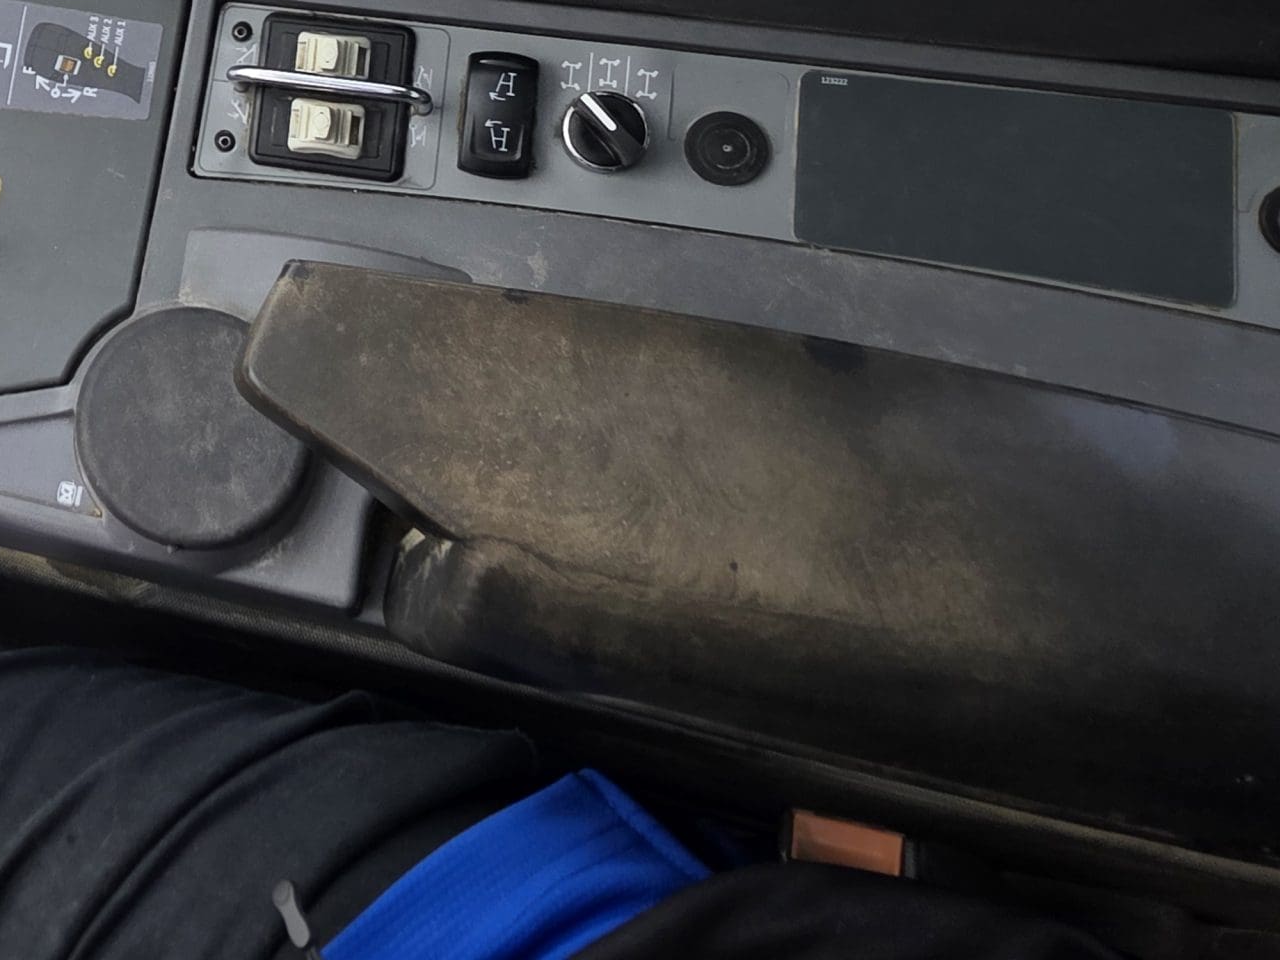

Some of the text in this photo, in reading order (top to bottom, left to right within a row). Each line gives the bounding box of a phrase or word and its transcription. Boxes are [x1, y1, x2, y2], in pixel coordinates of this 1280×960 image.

[86, 23, 98, 42] AUX
[100, 25, 111, 44] AUX
[114, 28, 125, 46] AUX
[22, 66, 36, 75] F
[83, 86, 98, 98] R
